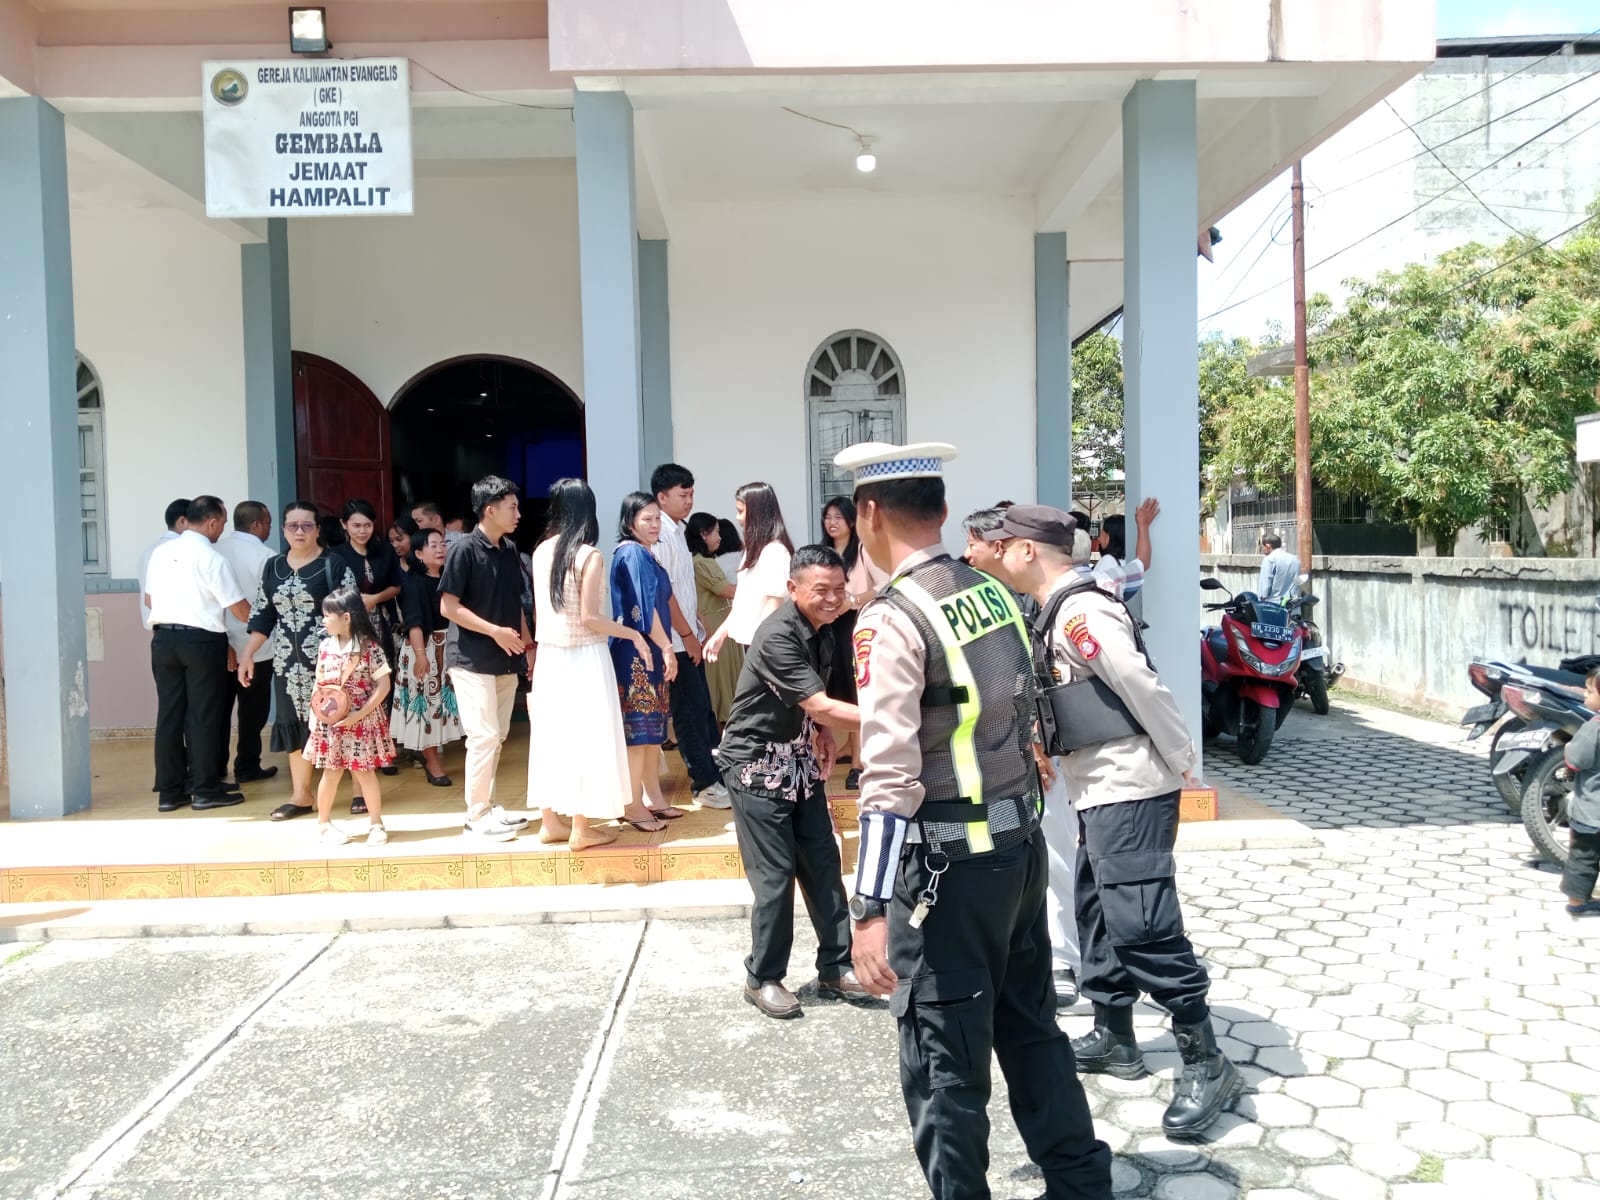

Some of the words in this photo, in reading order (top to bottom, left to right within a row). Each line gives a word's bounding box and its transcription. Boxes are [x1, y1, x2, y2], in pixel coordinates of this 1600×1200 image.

[257, 67, 291, 83] GEREJA
[293, 66, 348, 82] KALIMANTAN
[351, 65, 398, 82] EVANGELIS
[299, 111, 341, 127] ANGGOTA
[344, 110, 358, 126] PGI
[275, 132, 383, 154] GEMBALA
[289, 162, 367, 181] JEMAAT
[270, 187, 390, 207] HAMPALIT
[940, 585, 1013, 641] POLISI
[1499, 602, 1600, 655] TOILET
